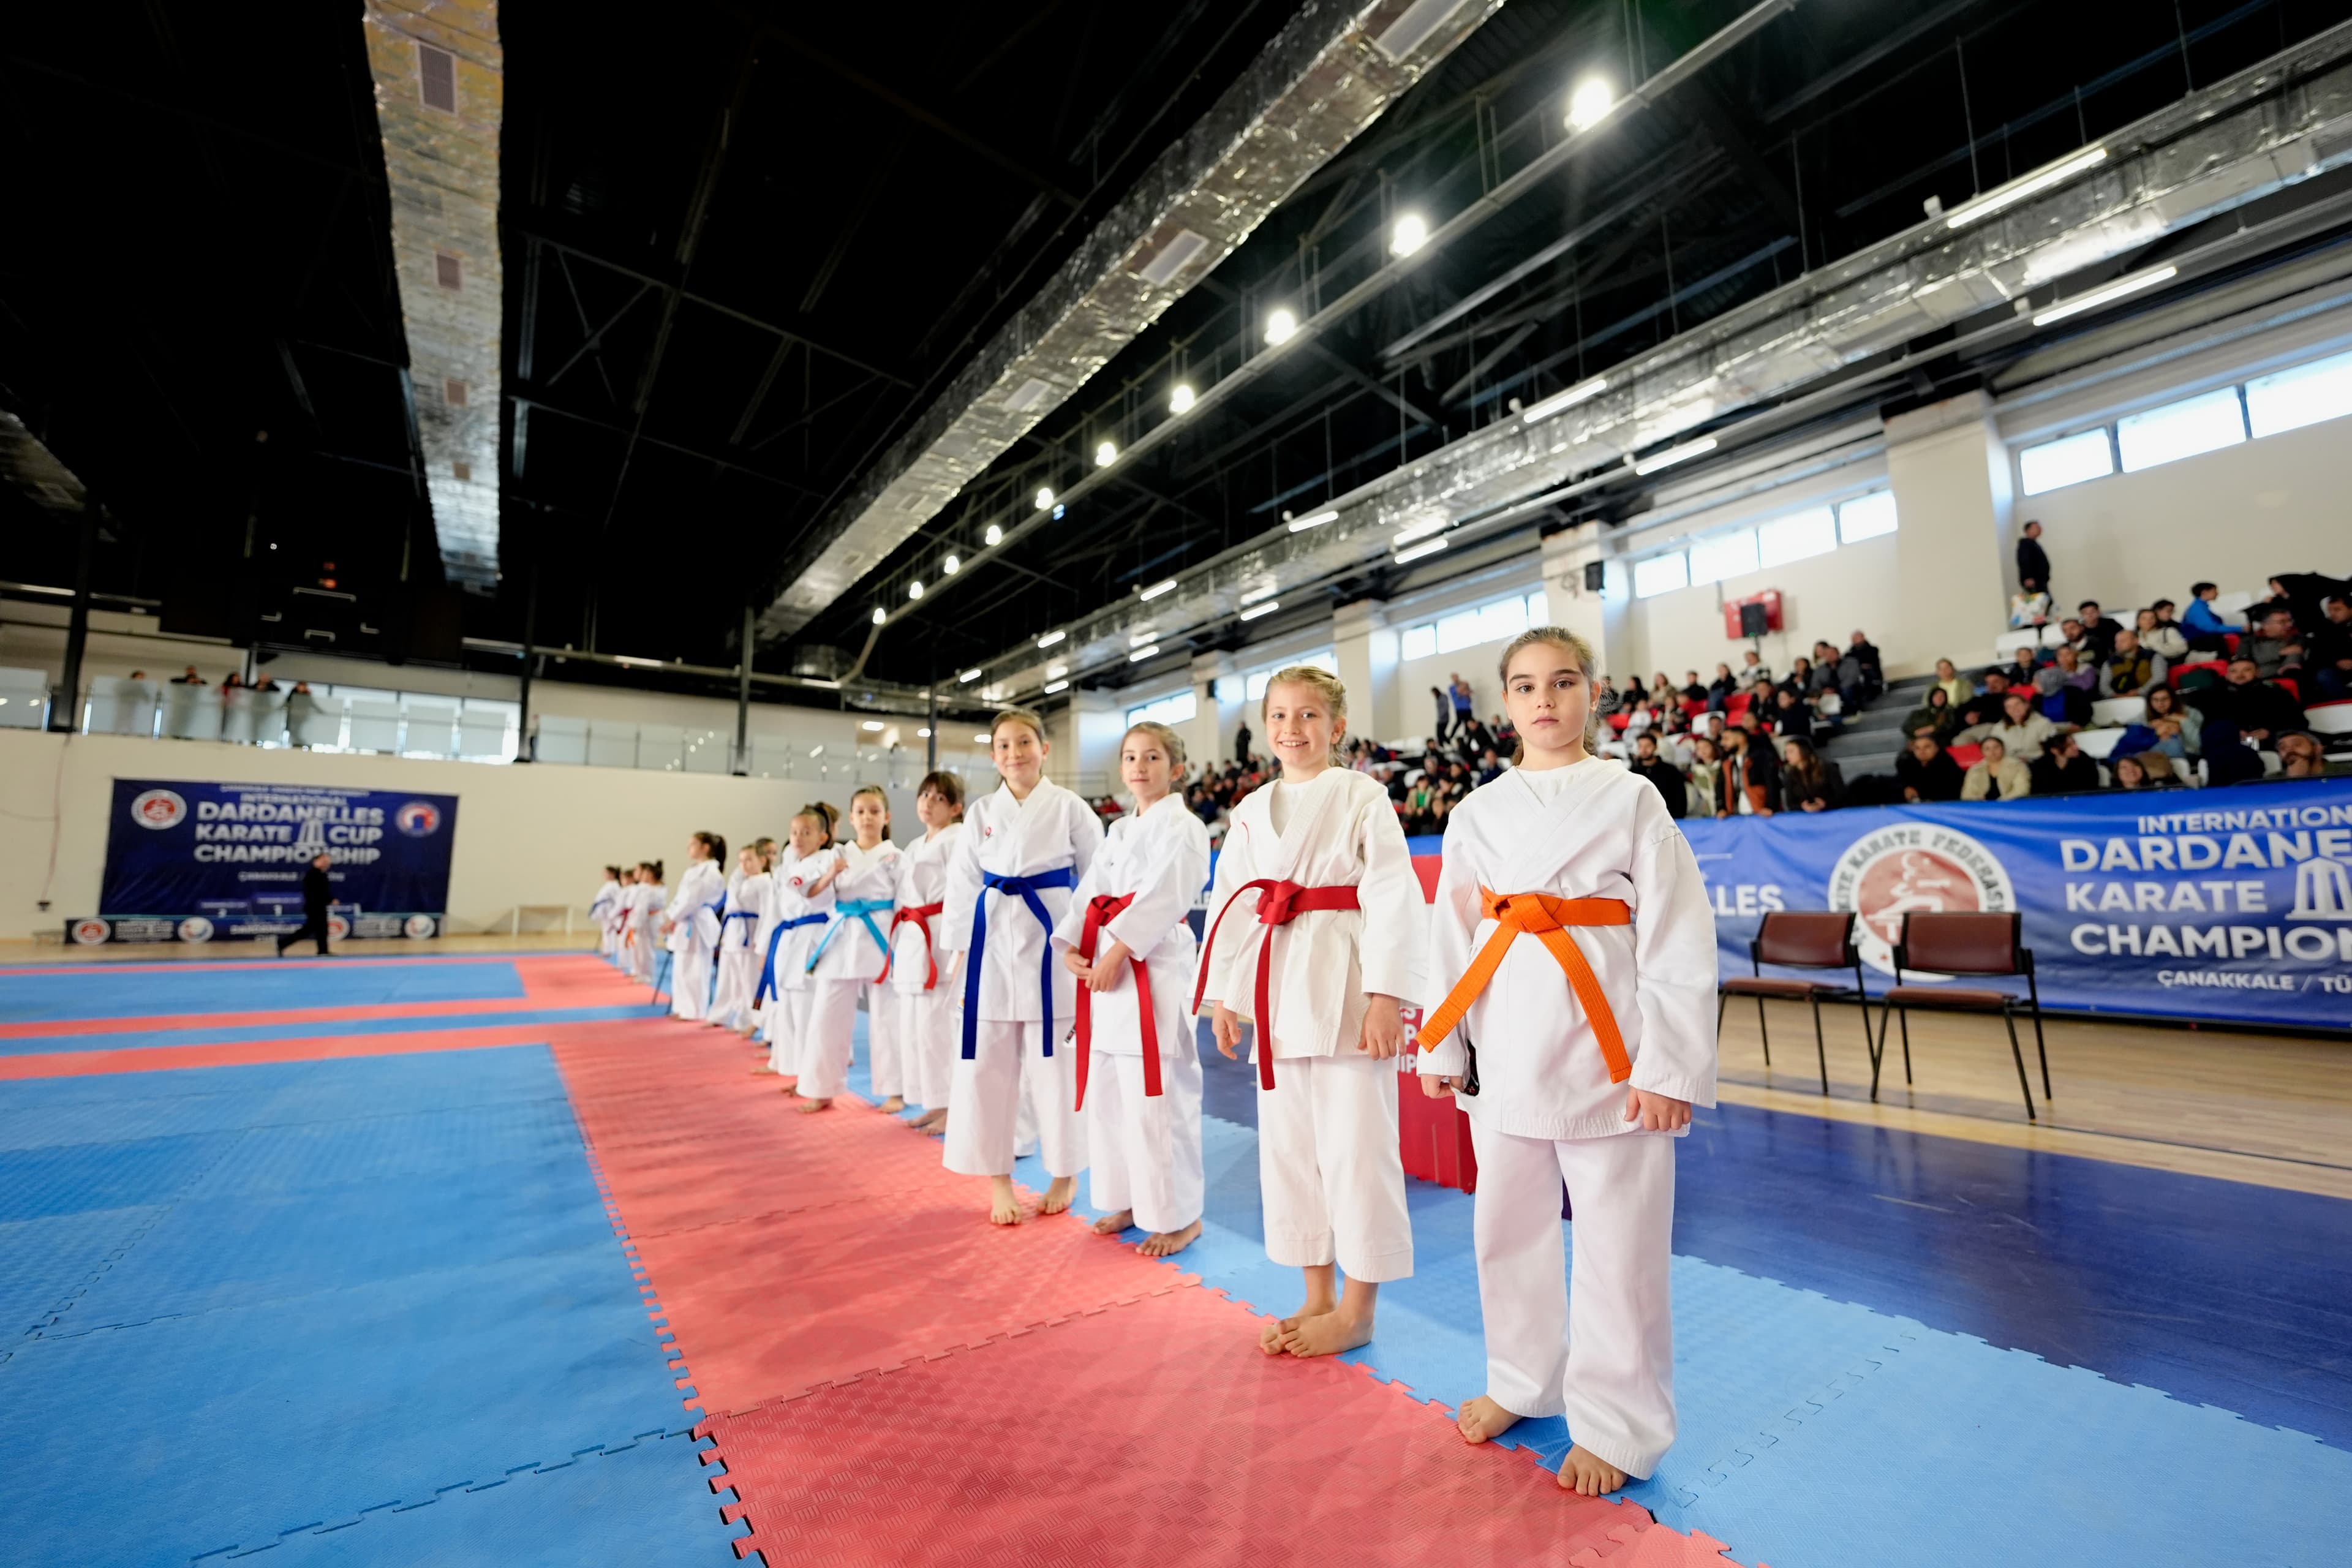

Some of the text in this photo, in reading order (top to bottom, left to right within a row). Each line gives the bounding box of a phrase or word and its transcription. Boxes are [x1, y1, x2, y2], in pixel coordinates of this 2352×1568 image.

[197, 801, 385, 827] DARDANELLES
[2138, 804, 2352, 834] INTERNATION
[195, 824, 384, 845] KARATE CUP
[1847, 830, 1921, 870] KARATE
[2060, 829, 2352, 872] DARDANE
[2065, 881, 2268, 913] KARATE
[2157, 970, 2294, 990] ÇANAKKALE
